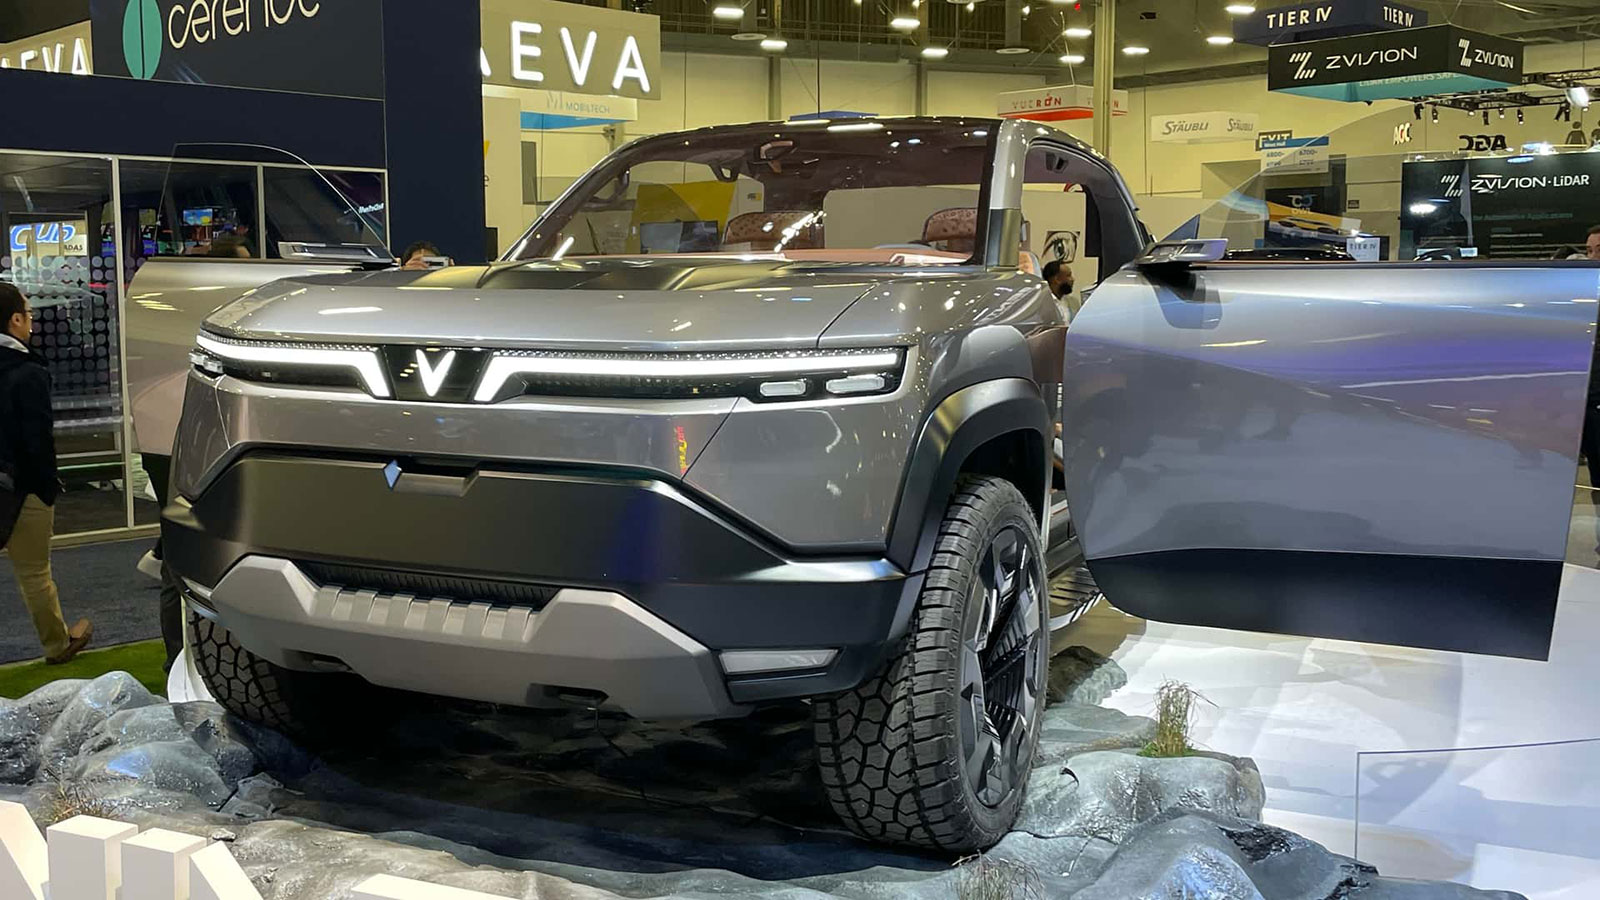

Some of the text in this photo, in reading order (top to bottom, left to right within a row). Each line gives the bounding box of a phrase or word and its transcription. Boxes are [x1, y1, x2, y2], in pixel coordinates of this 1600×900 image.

[1267, 6, 1333, 29] TIER IV
[1383, 6, 1405, 25] TIER
[1325, 46, 1418, 70] ZVISION
[1474, 49, 1514, 69] ZVISION
[1393, 122, 1412, 145] AGC
